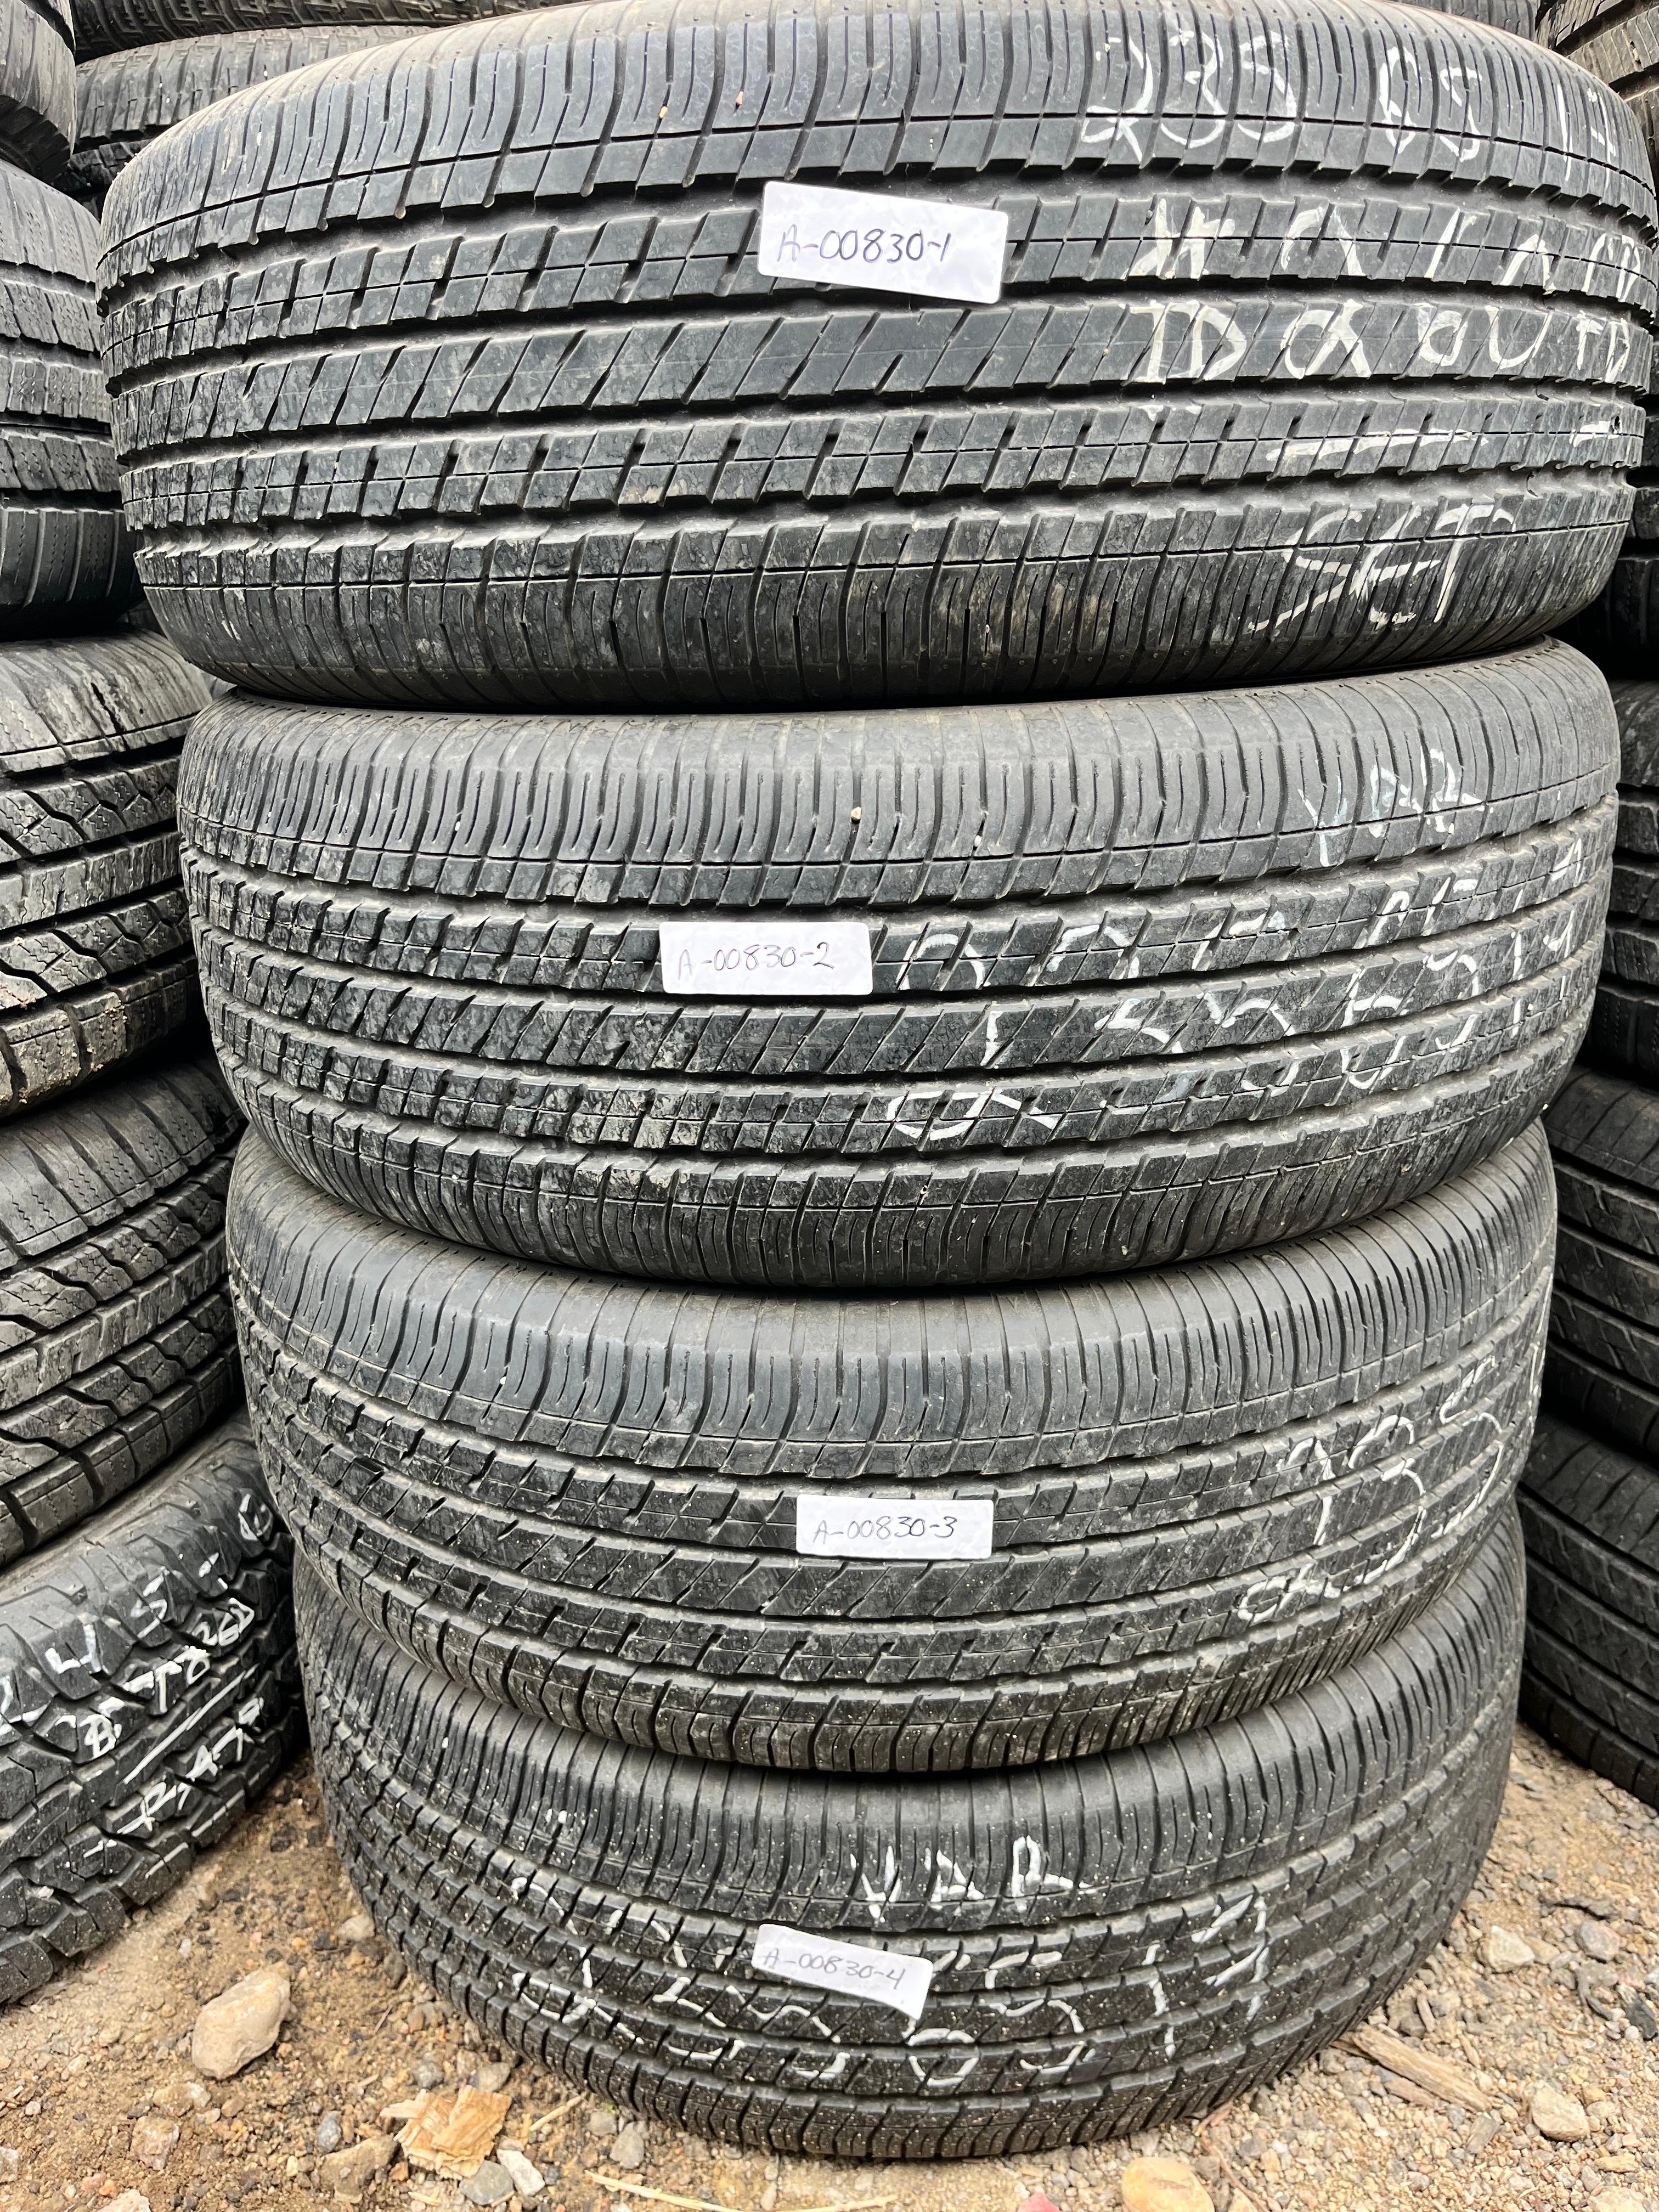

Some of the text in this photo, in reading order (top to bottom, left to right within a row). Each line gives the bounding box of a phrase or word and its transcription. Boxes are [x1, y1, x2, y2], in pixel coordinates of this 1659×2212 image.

[1080, 29, 1298, 162] 235
[777, 223, 952, 263] A-00830-1
[678, 941, 836, 980] A-00830-2
[812, 1516, 958, 1545] A-00830-3
[763, 1947, 906, 1990] A-00830-4
